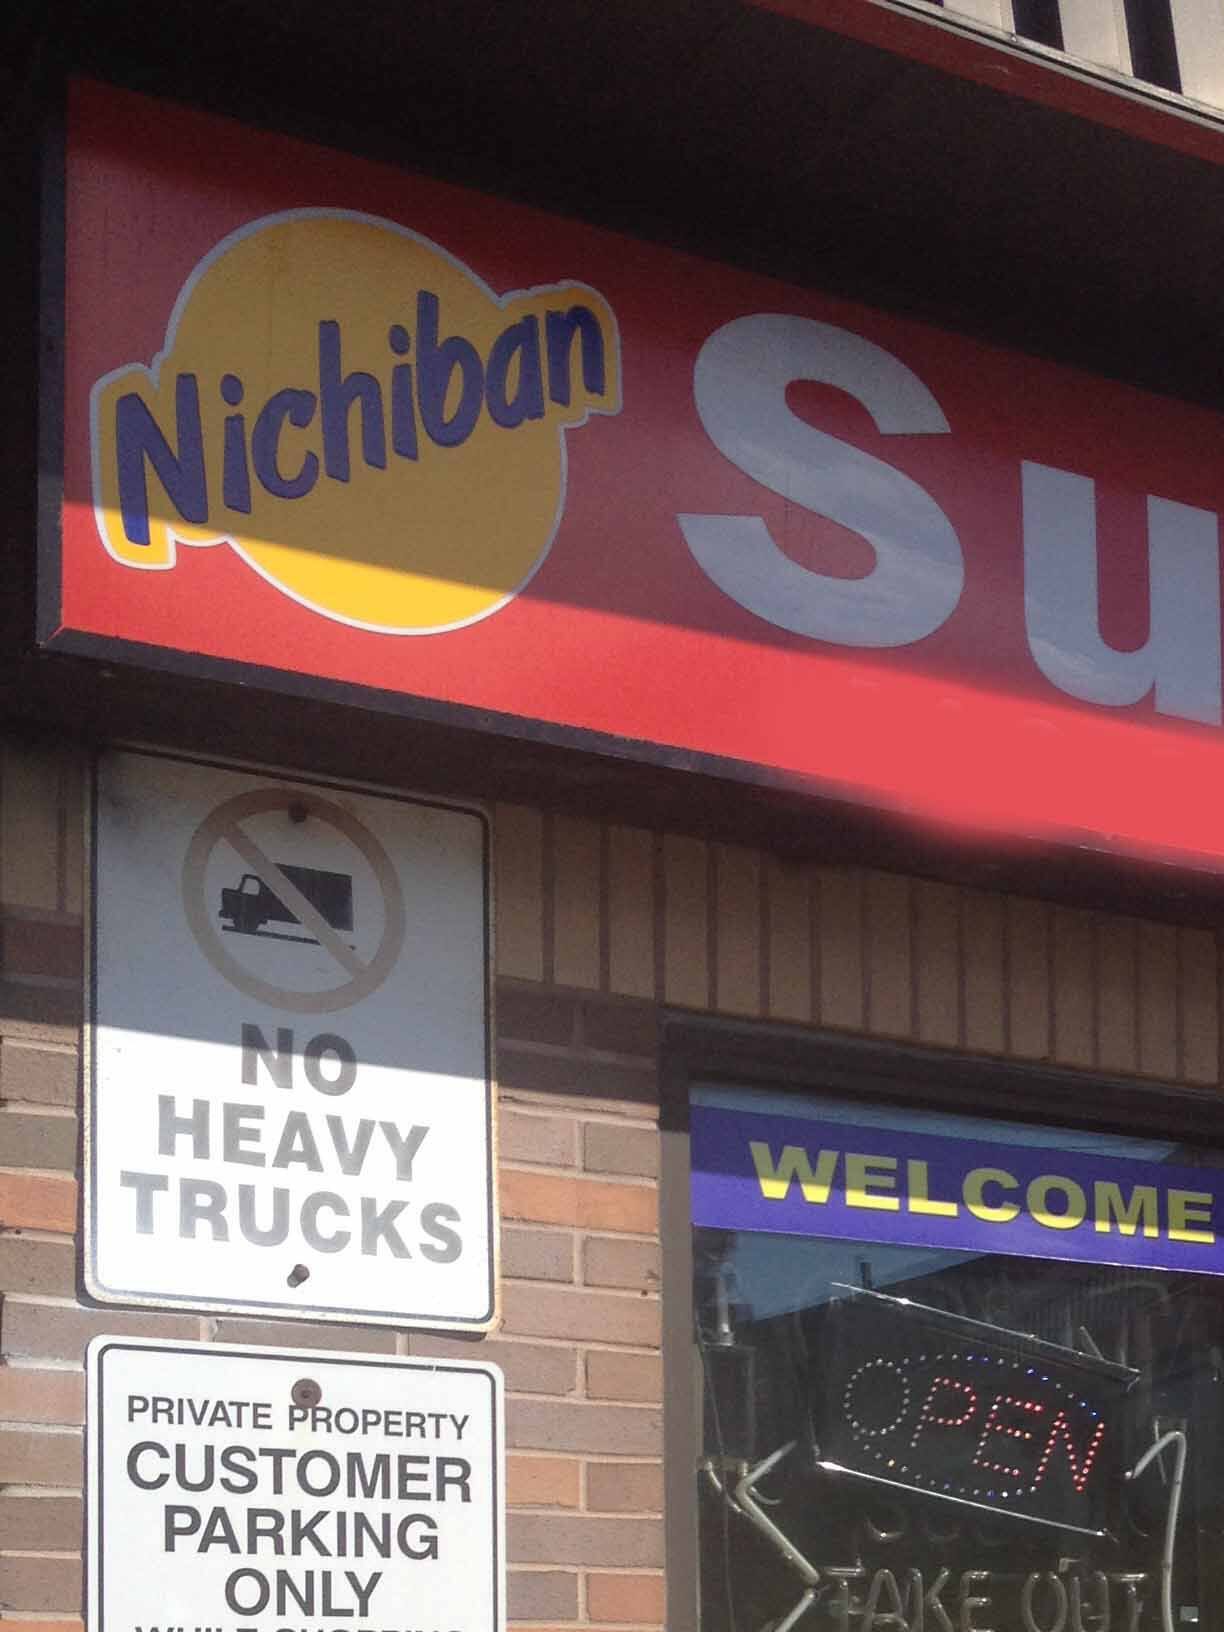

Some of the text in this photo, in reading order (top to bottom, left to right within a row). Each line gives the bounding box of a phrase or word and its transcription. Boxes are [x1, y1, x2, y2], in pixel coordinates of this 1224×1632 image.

[116, 290, 605, 547] Nichiban
[240, 1022, 358, 1097] NO
[156, 1094, 430, 1182] HEAVY
[120, 1169, 464, 1265] TRUCKS
[749, 1140, 1216, 1244] WELCOME
[127, 1394, 470, 1441] PRIVATE PROPERTY
[844, 1357, 1105, 1493] OPEN
[126, 1440, 473, 1504] CUSTOMER
[163, 1503, 440, 1561] PARKING
[224, 1566, 384, 1619] ONLY
